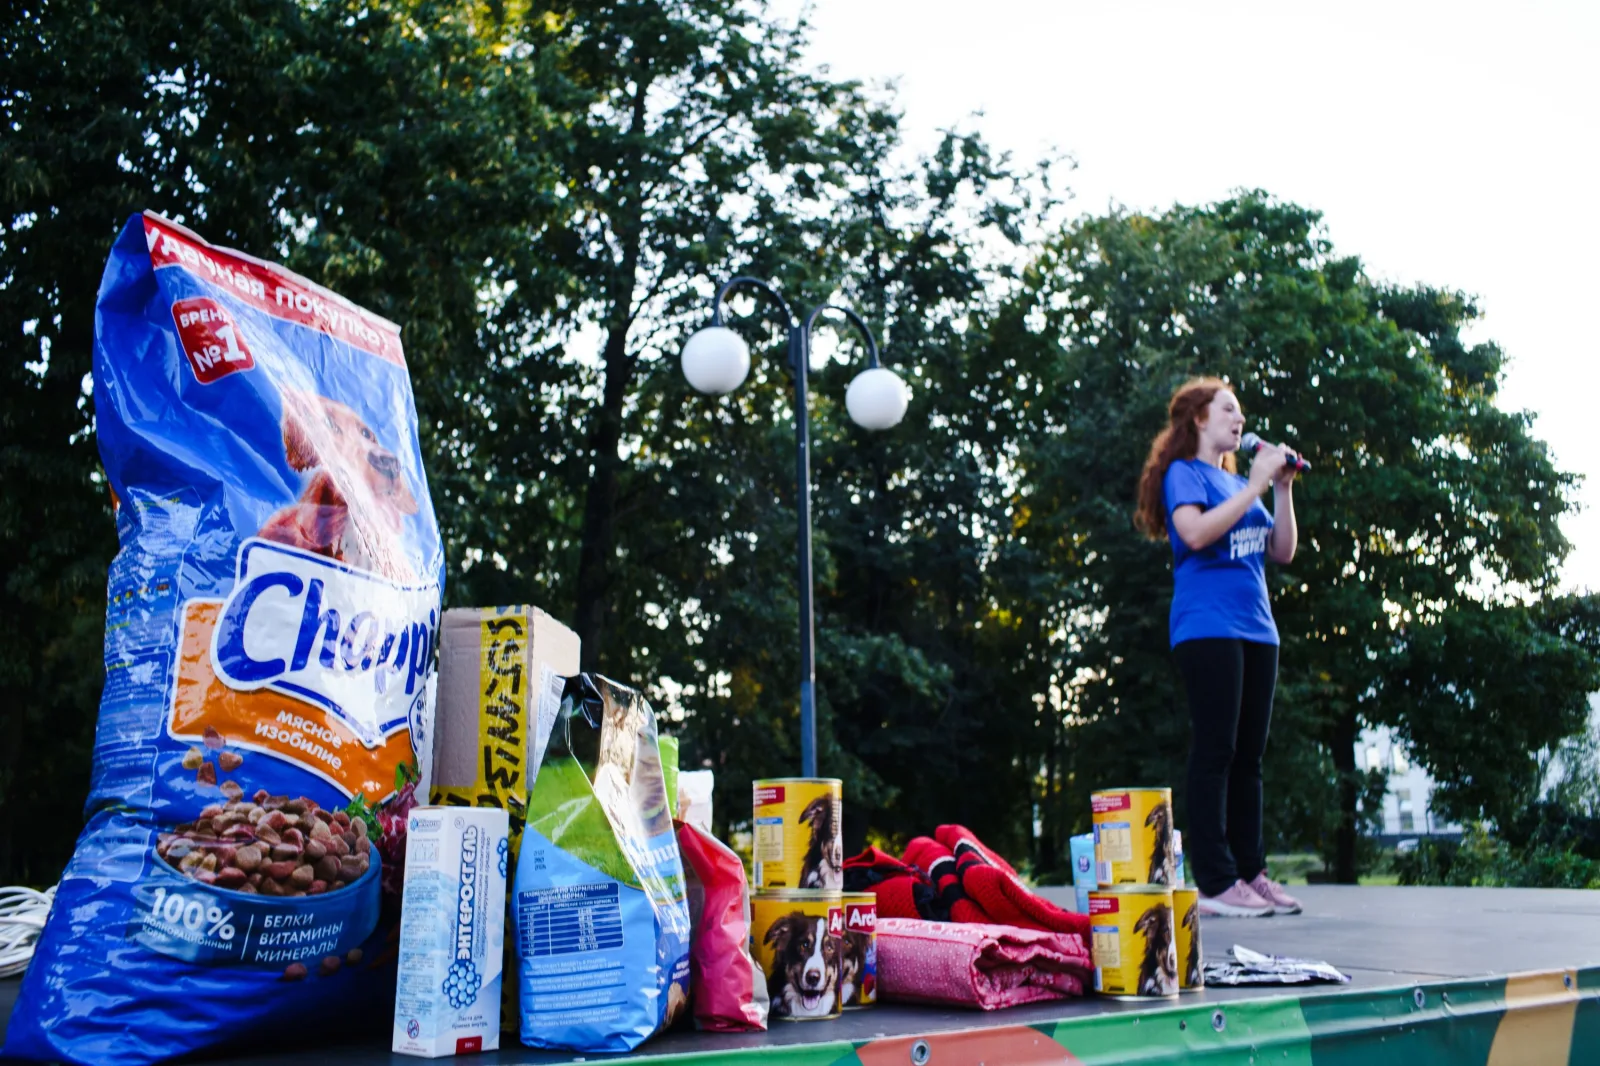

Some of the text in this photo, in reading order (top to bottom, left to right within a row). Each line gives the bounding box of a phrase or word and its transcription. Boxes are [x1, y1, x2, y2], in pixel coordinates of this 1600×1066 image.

[217, 572, 436, 695] Chappi
[255, 721, 342, 770] изобилие
[276, 710, 342, 749] мясное
[151, 887, 235, 940] 100%
[457, 825, 478, 960] ЭНТЕРОСГЕЛЬ
[259, 920, 344, 945] ВИТАМИНЫ
[264, 912, 314, 928] БЕЛКИ
[255, 938, 338, 962] МИНЕРАЛЫ
